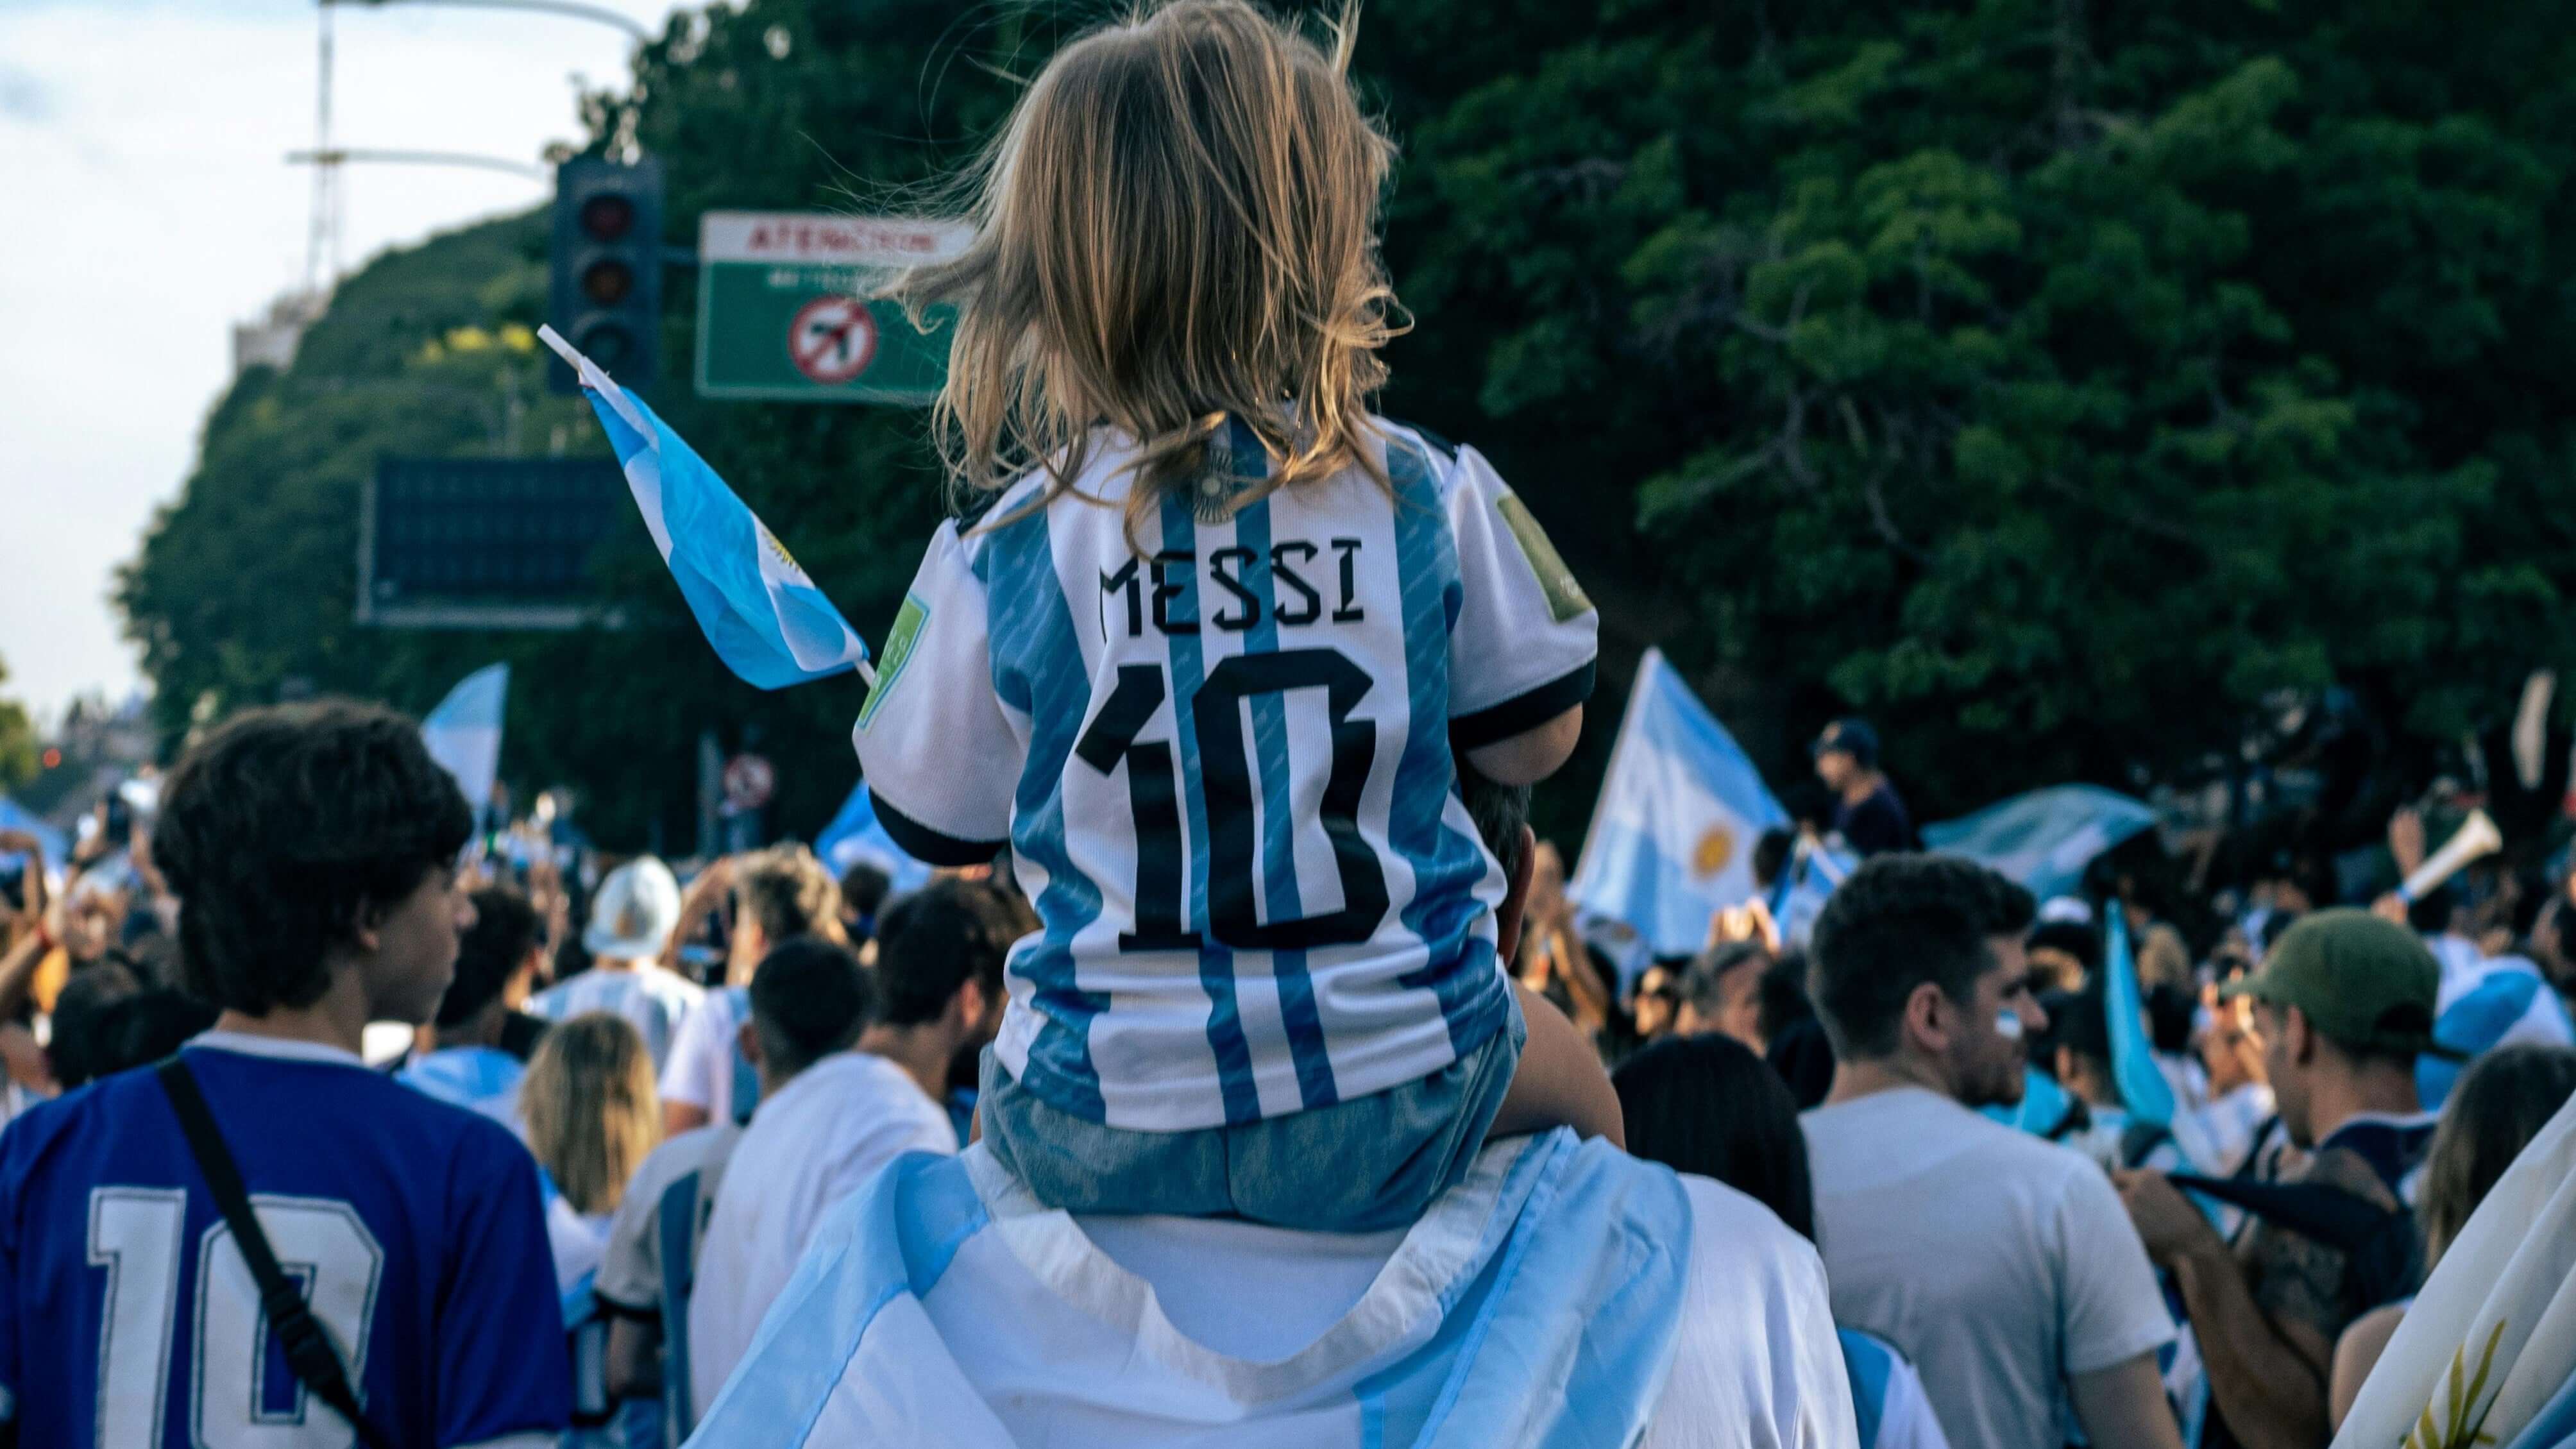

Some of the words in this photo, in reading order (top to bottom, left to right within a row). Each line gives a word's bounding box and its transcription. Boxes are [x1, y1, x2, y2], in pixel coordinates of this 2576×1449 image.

[1099, 538, 1365, 643] MESSI
[1075, 648, 1391, 953] 10
[87, 1185, 385, 1449] 10
